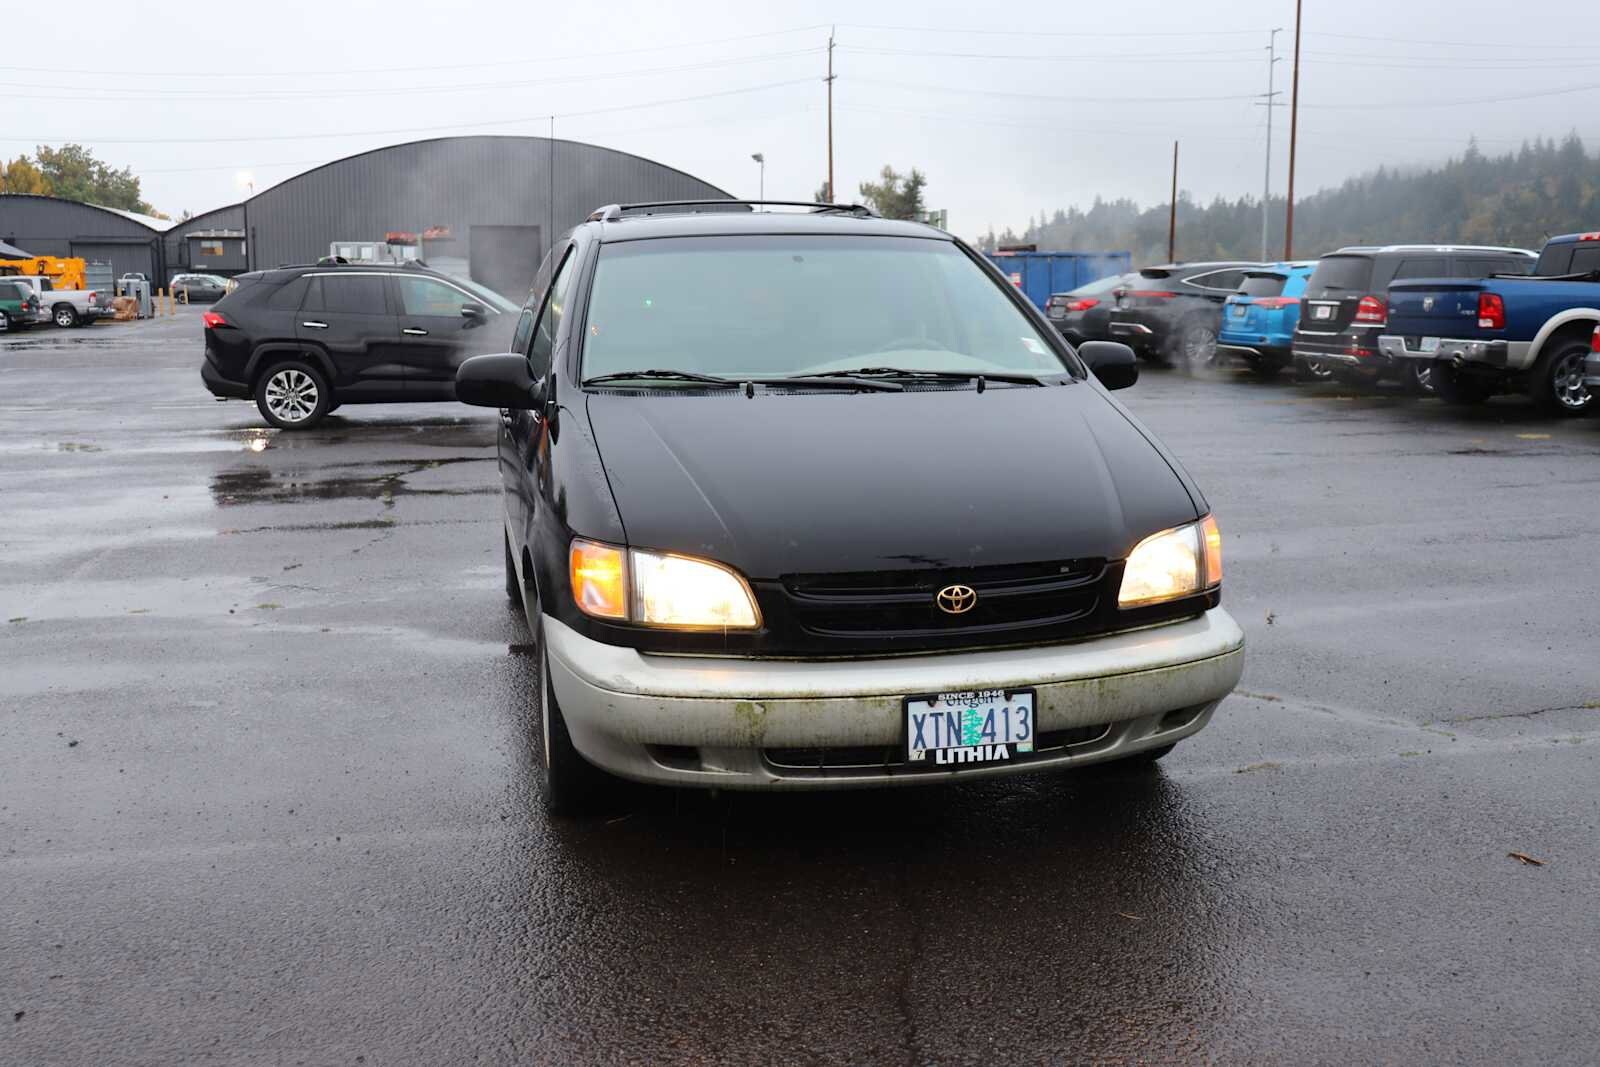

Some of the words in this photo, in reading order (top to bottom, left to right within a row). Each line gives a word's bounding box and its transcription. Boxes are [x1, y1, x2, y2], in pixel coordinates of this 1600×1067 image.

[938, 692, 975, 701] SINCE
[946, 697, 994, 708] Oregon
[912, 710, 962, 750] XTN
[981, 706, 1030, 743] 413
[935, 744, 1010, 765] LITHIA
